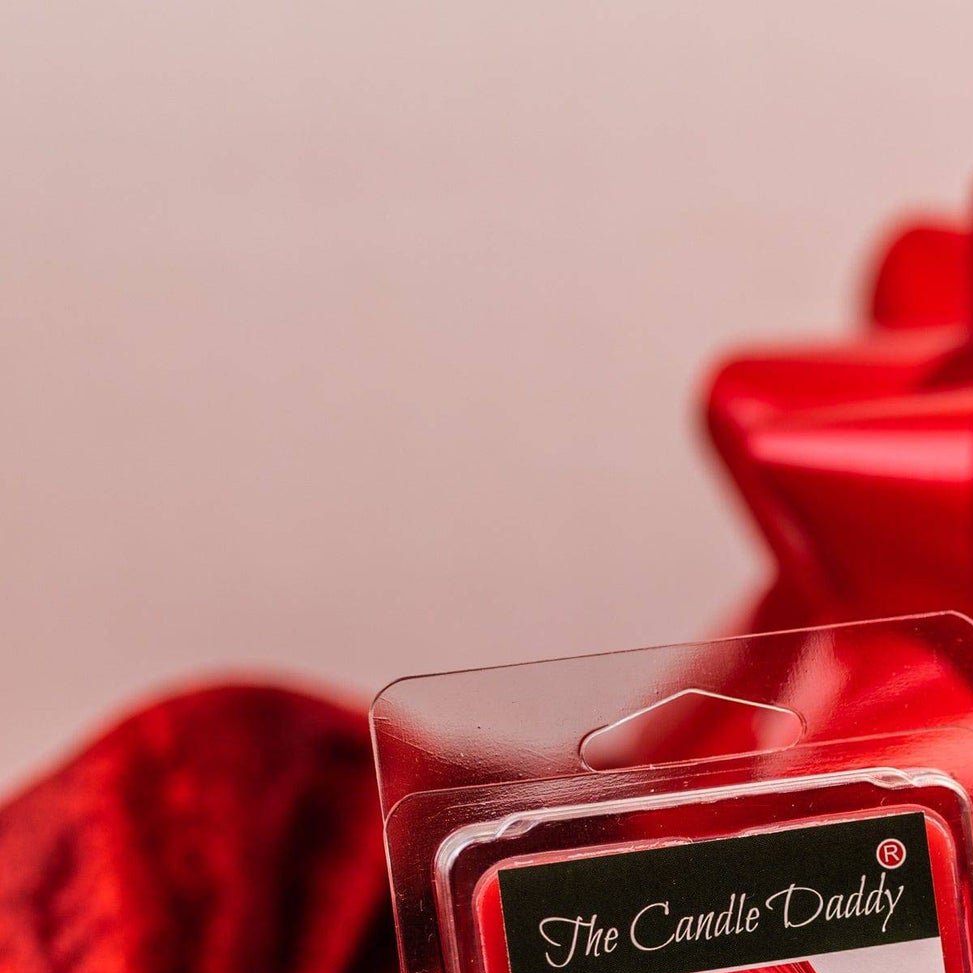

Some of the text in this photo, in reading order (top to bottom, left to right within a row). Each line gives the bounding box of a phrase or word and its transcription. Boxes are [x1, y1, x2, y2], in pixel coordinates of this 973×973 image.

[539, 872, 904, 968] The Candle Daddy
